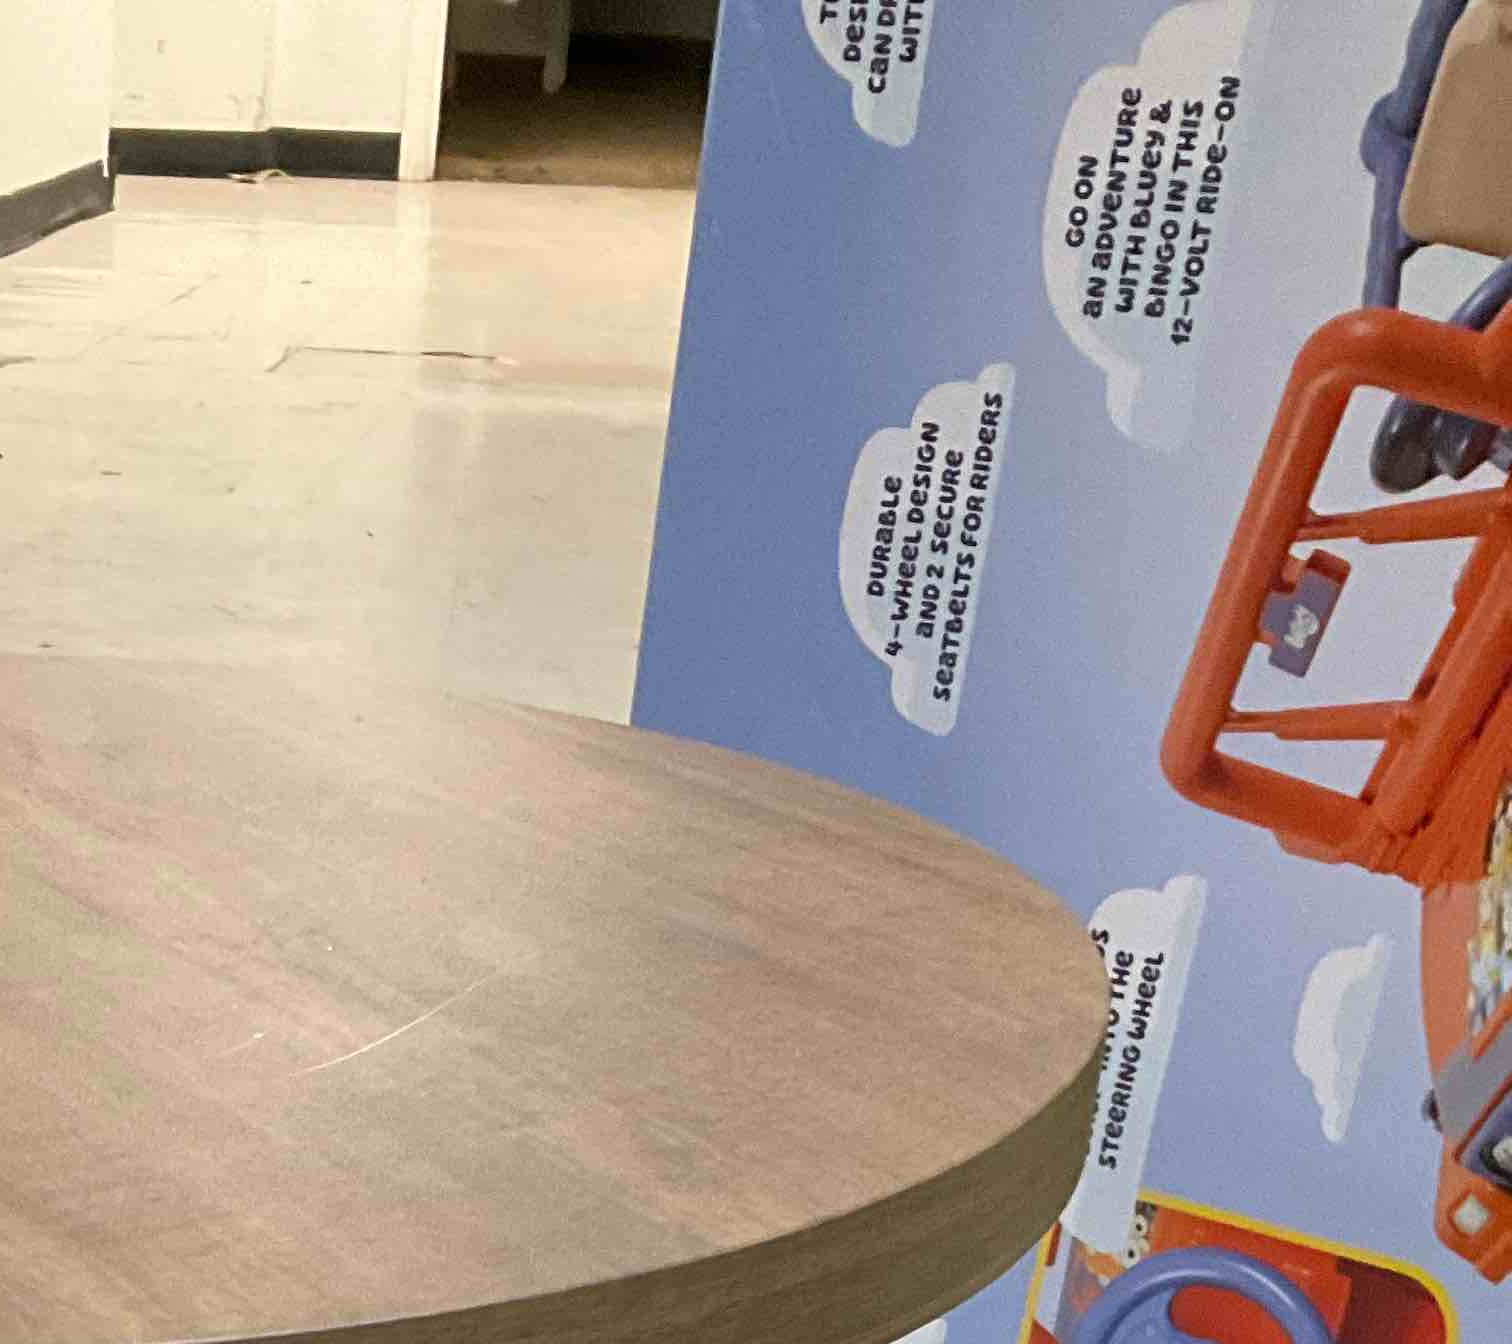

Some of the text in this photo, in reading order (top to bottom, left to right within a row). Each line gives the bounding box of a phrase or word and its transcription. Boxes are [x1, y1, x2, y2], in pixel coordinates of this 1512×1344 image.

[1065, 155, 1098, 247] GO ON
[1115, 235, 1146, 313] WITH
[1149, 99, 1173, 125] &
[1144, 100, 1204, 317] BINGO IN THIS
[960, 494, 986, 547] FOR
[926, 563, 945, 580] 2
